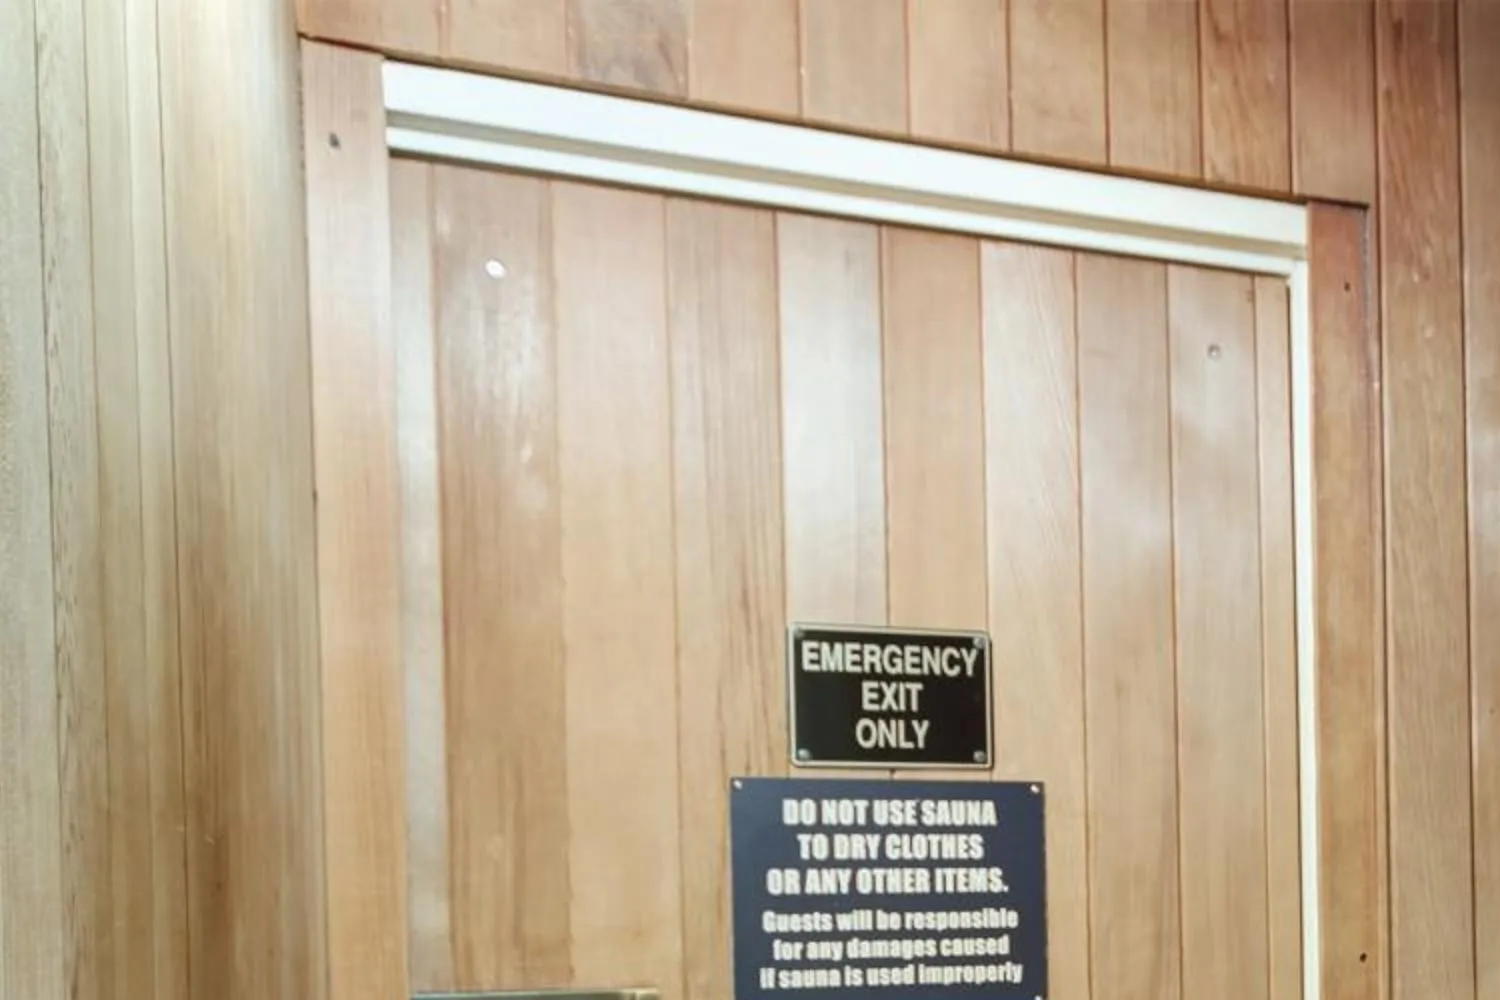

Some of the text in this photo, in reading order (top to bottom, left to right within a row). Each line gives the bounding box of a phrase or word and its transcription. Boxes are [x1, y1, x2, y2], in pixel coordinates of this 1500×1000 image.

[802, 641, 978, 677] EMERGENCY
[861, 682, 923, 713] EXIT
[855, 720, 929, 749] ONLY
[782, 800, 997, 826] DO NOT USE SAUNA
[798, 834, 983, 860] TO DRY CLOTHES
[766, 869, 1009, 894] OR ANY OTHER ITEMS.
[762, 908, 1019, 933] Guests will be responsible
[773, 936, 1010, 962] for any damages caused
[778, 968, 841, 988] sauna
[844, 966, 863, 986] is
[866, 965, 915, 986] used
[918, 962, 1023, 988] improperly
